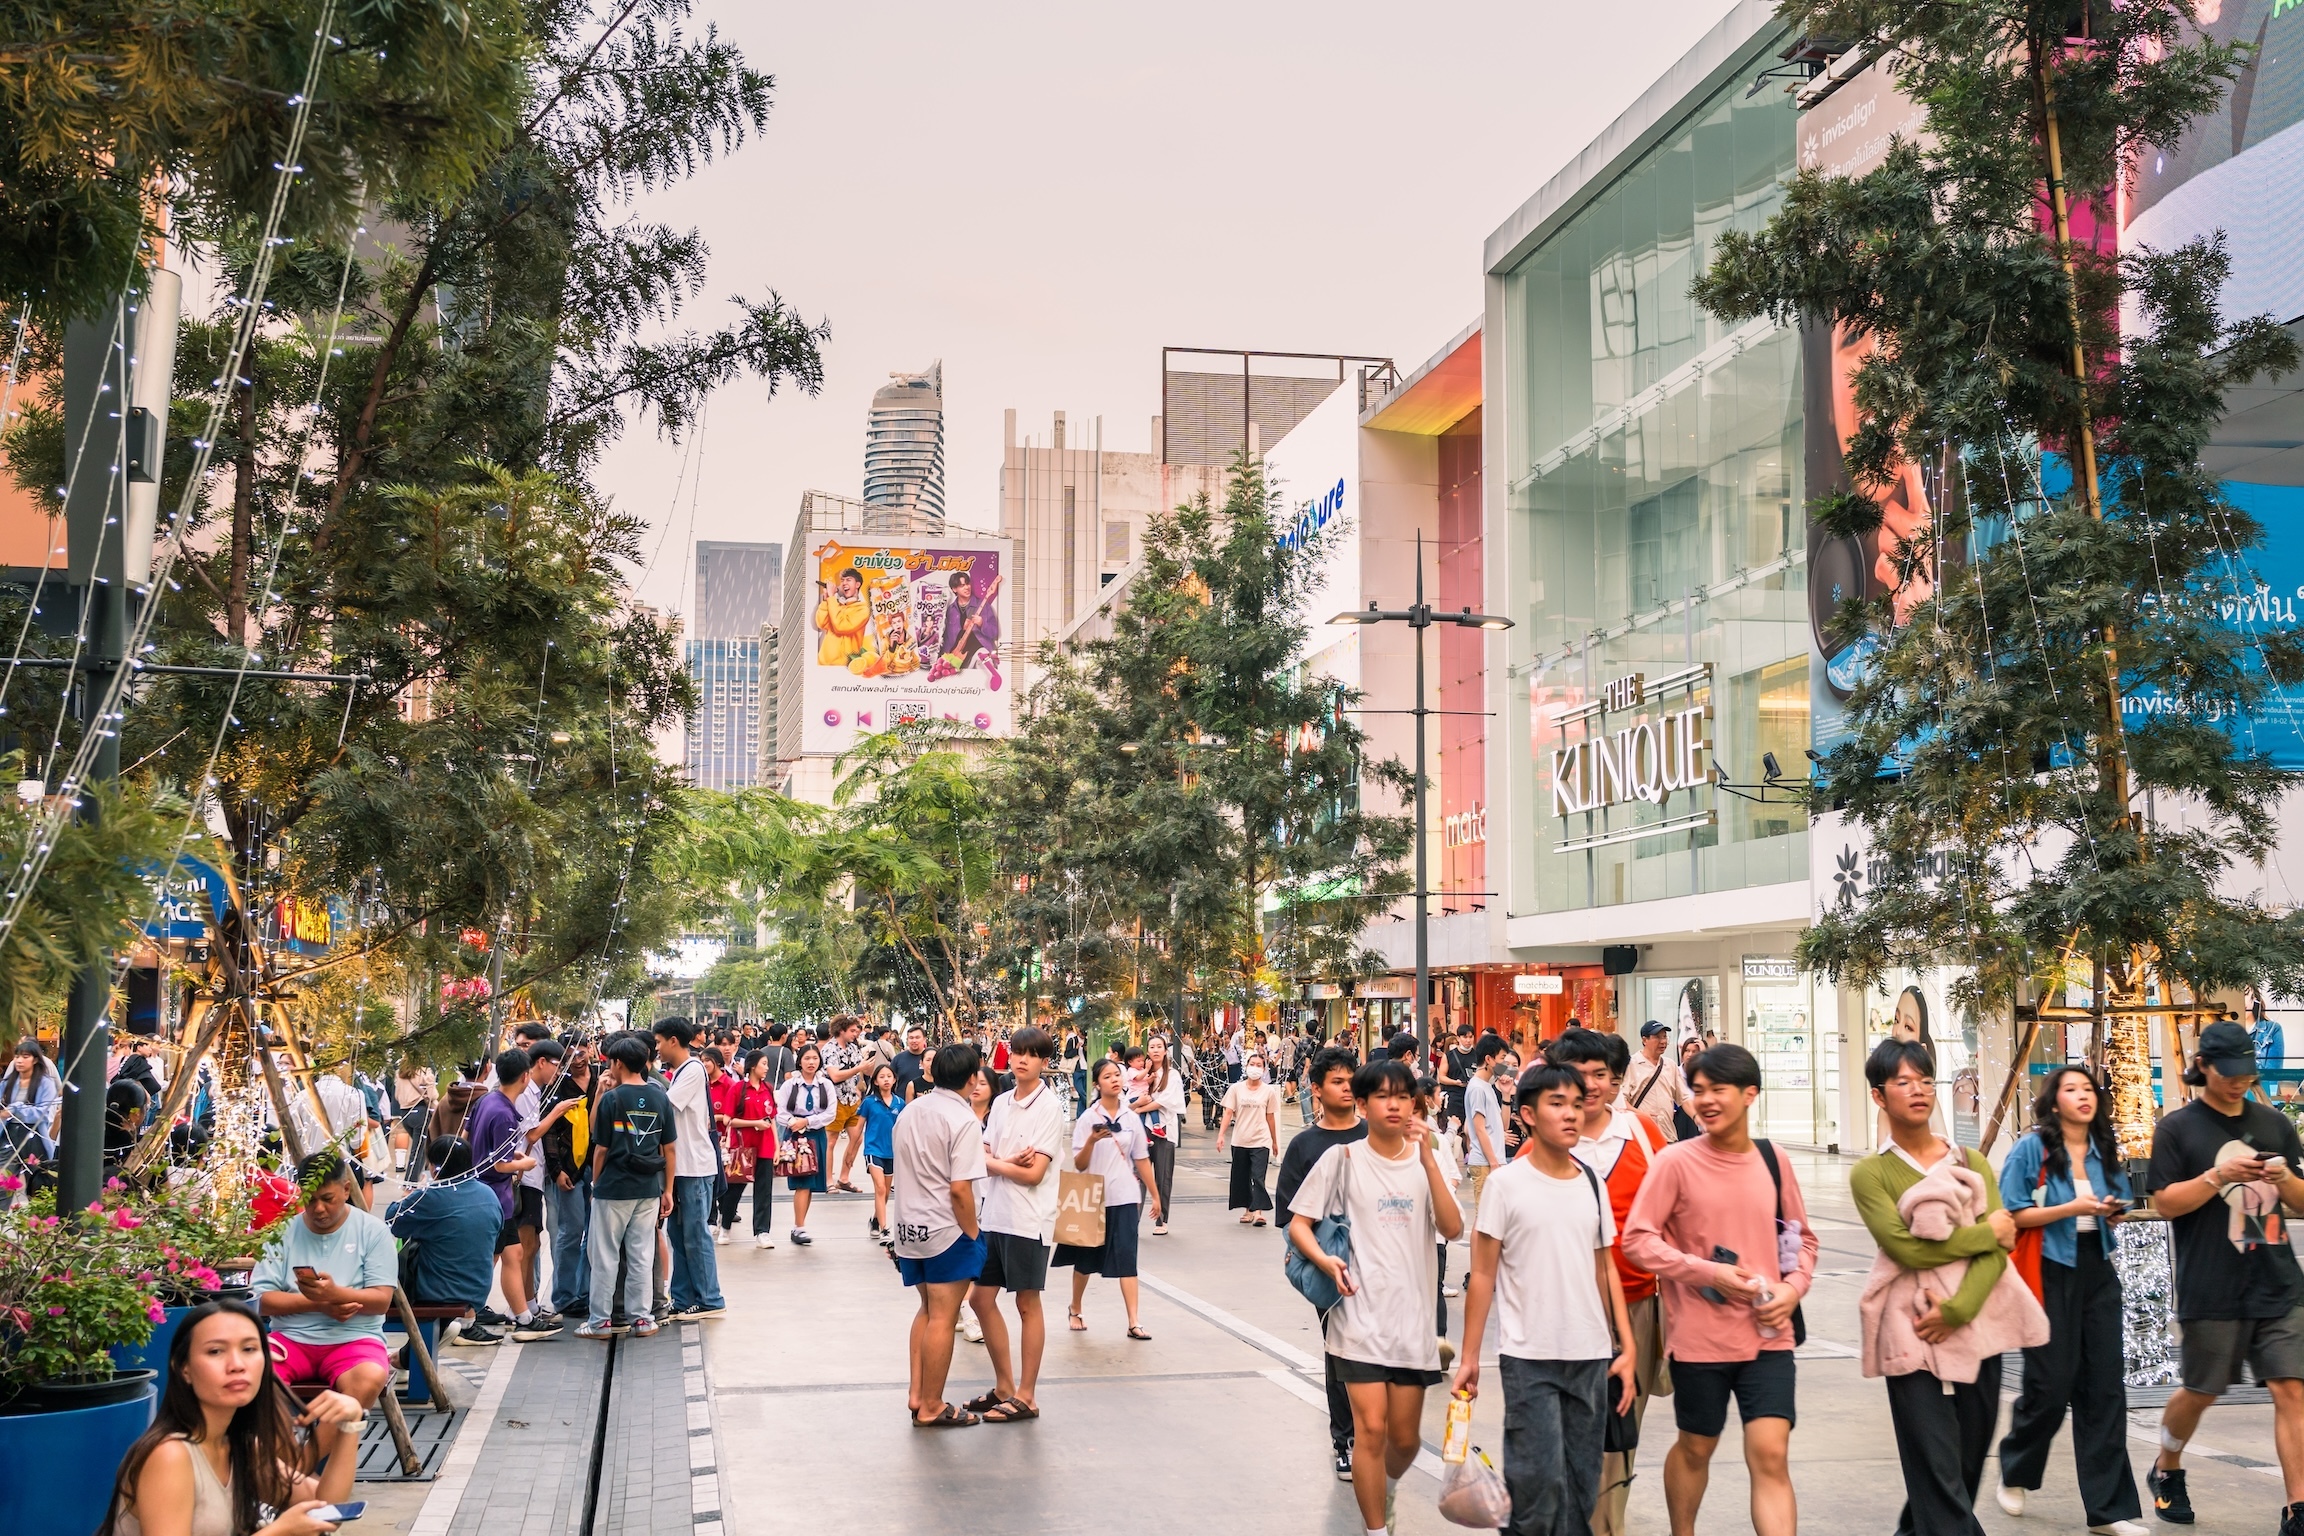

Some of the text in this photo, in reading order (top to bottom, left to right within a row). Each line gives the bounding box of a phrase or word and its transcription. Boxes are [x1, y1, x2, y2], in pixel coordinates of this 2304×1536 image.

[1605, 672, 1644, 714] THE
[1551, 706, 1717, 818] KLINIQUE
[199, 947, 208, 961] 3
[1518, 981, 1559, 989] matchbox
[1377, 1199, 1413, 1212] CHAMPIONS
